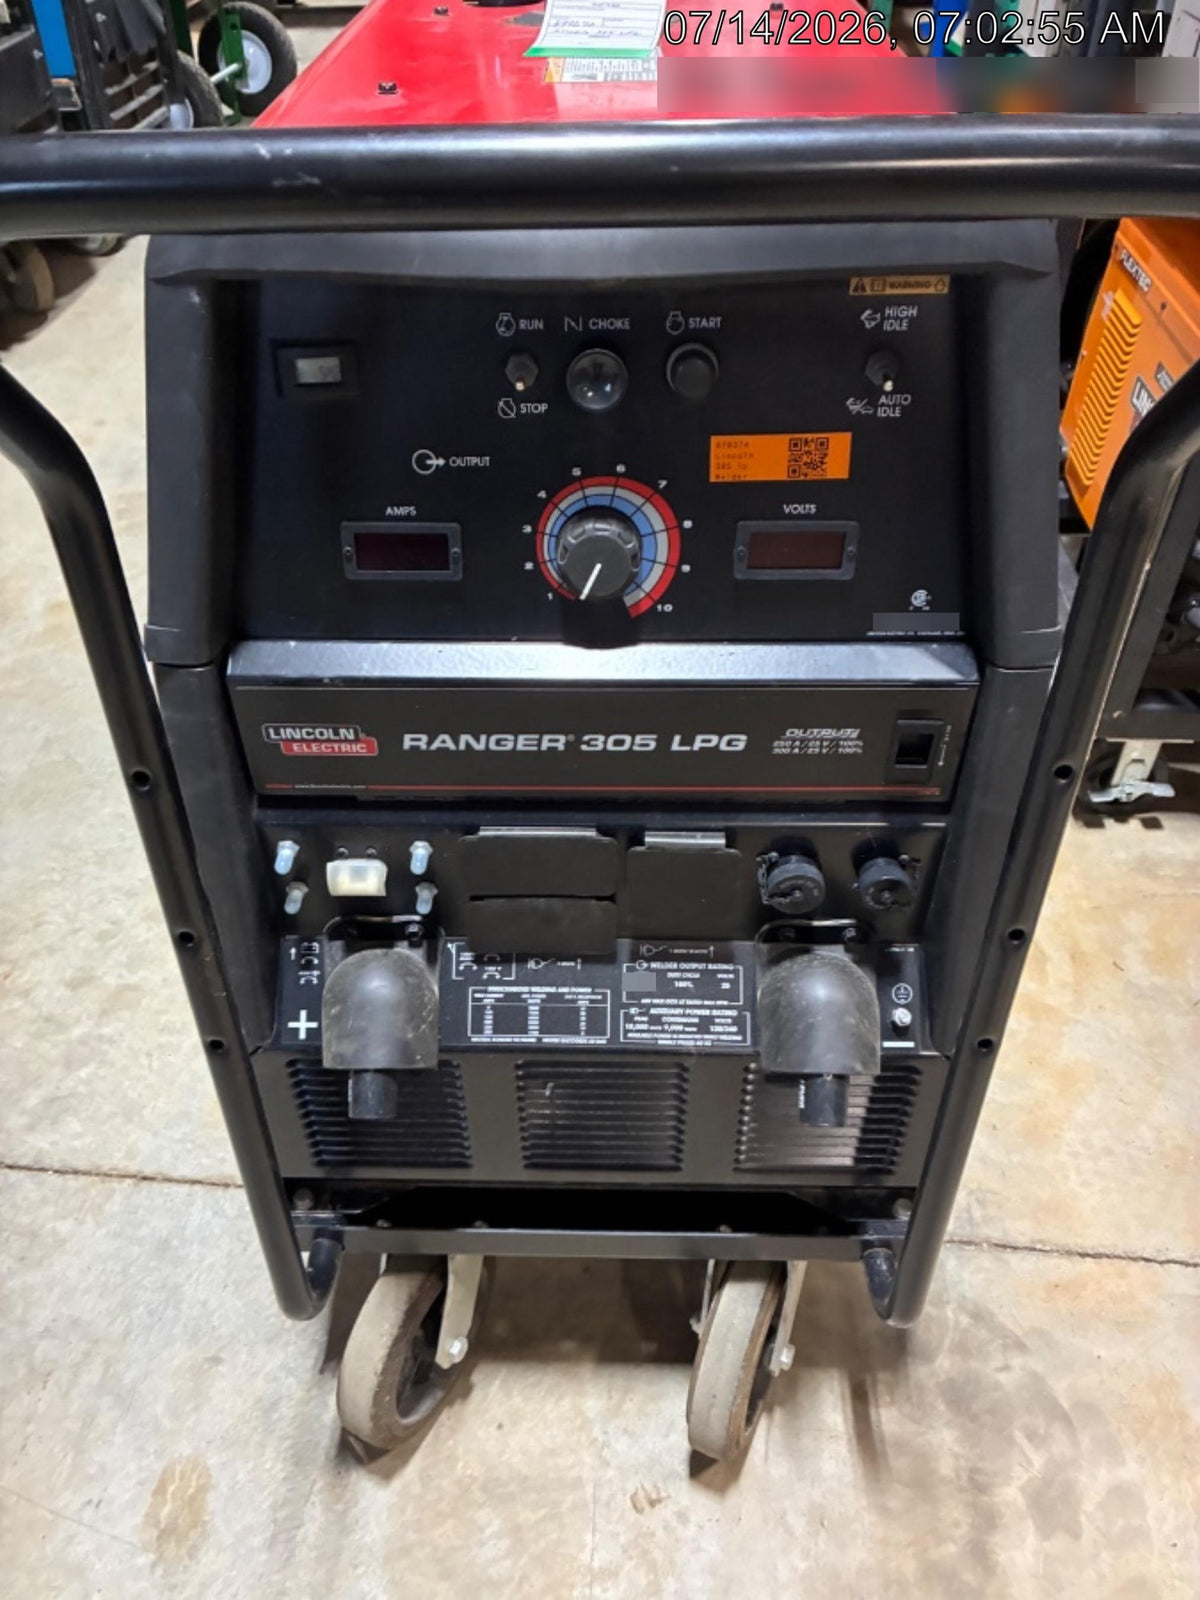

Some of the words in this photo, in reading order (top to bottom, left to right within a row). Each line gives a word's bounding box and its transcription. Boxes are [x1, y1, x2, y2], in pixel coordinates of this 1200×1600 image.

[884, 305, 918, 318] HIGH
[519, 318, 544, 331] RUN
[588, 318, 631, 331] CHOKE
[688, 317, 722, 329] START
[883, 319, 909, 331] IDLE
[878, 394, 912, 405] AUTO
[519, 402, 548, 415] STOP
[877, 406, 902, 417] IDLE
[449, 456, 490, 468] OUTPUT
[572, 467, 581, 476] 5
[616, 464, 626, 473] 6
[658, 480, 668, 489] 7
[537, 490, 547, 499] 4
[385, 506, 417, 516] AMPS
[783, 504, 817, 515] VOLTS
[522, 525, 533, 533] 3
[683, 520, 692, 529] 8
[524, 562, 534, 570] 2
[681, 564, 691, 573] 9
[547, 593, 553, 601] 1
[656, 604, 673, 613] 10
[268, 727, 356, 741] LINCOLN
[293, 742, 368, 754] ELECTRIC
[581, 734, 657, 751] 305
[671, 735, 748, 751] LPG
